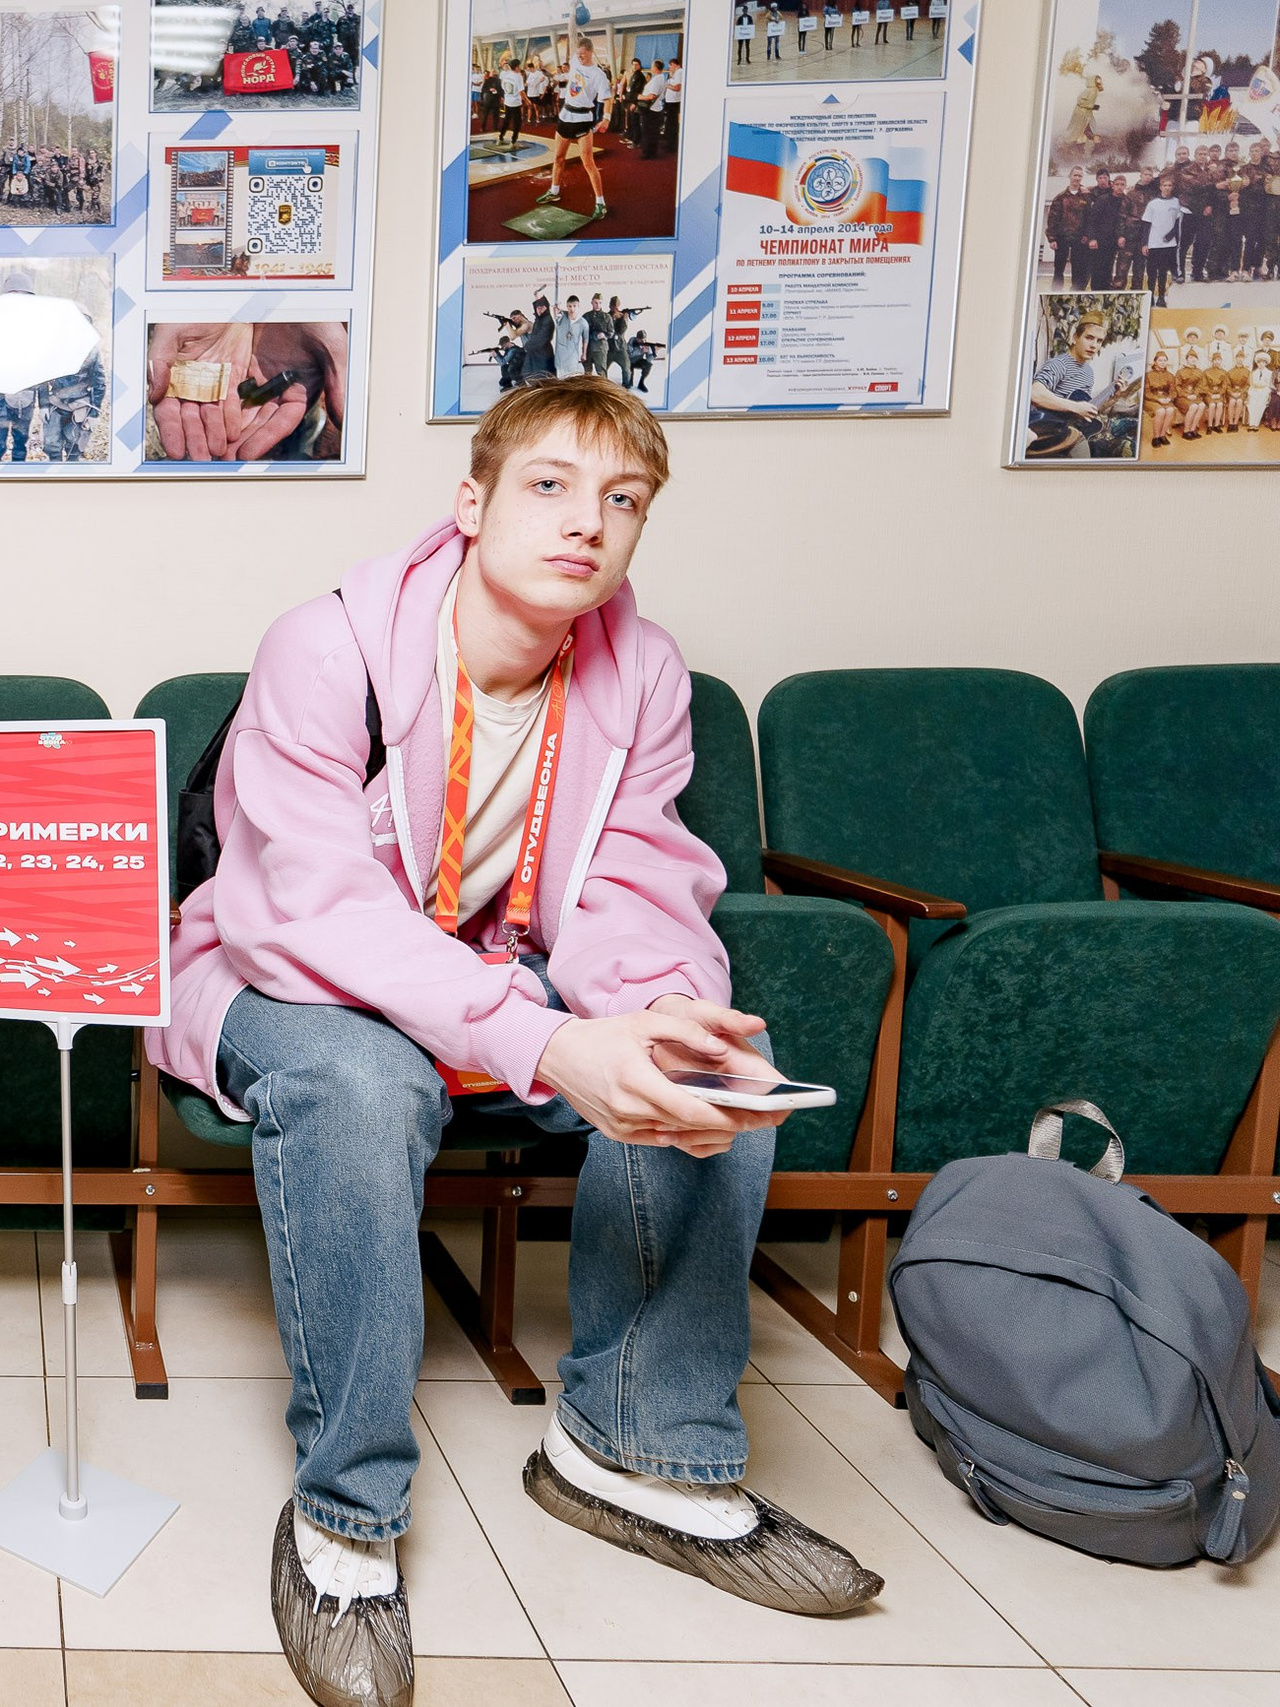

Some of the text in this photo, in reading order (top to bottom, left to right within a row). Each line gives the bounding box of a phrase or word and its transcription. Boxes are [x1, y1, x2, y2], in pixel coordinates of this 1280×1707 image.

[243, 74, 276, 84] НОРД
[797, 225, 834, 235] апреля
[838, 223, 865, 233] 2014
[868, 224, 893, 234] года
[760, 237, 889, 255] ЧЕМПИОНАТ МИРА
[736, 259, 745, 267] ПО
[746, 259, 776, 267] ЛЕТНЕМУ
[778, 258, 820, 266] ПОЛИАТЛОНУ
[828, 257, 864, 265] ЗАКРЫТЫХ
[866, 256, 911, 265] ПОМЕЩЕНИЯХ
[469, 267, 520, 275] ПОЗДРАВЛЯЕМ
[20, 854, 58, 871] 23,
[65, 855, 104, 871] 24,
[112, 855, 145, 869] 25
